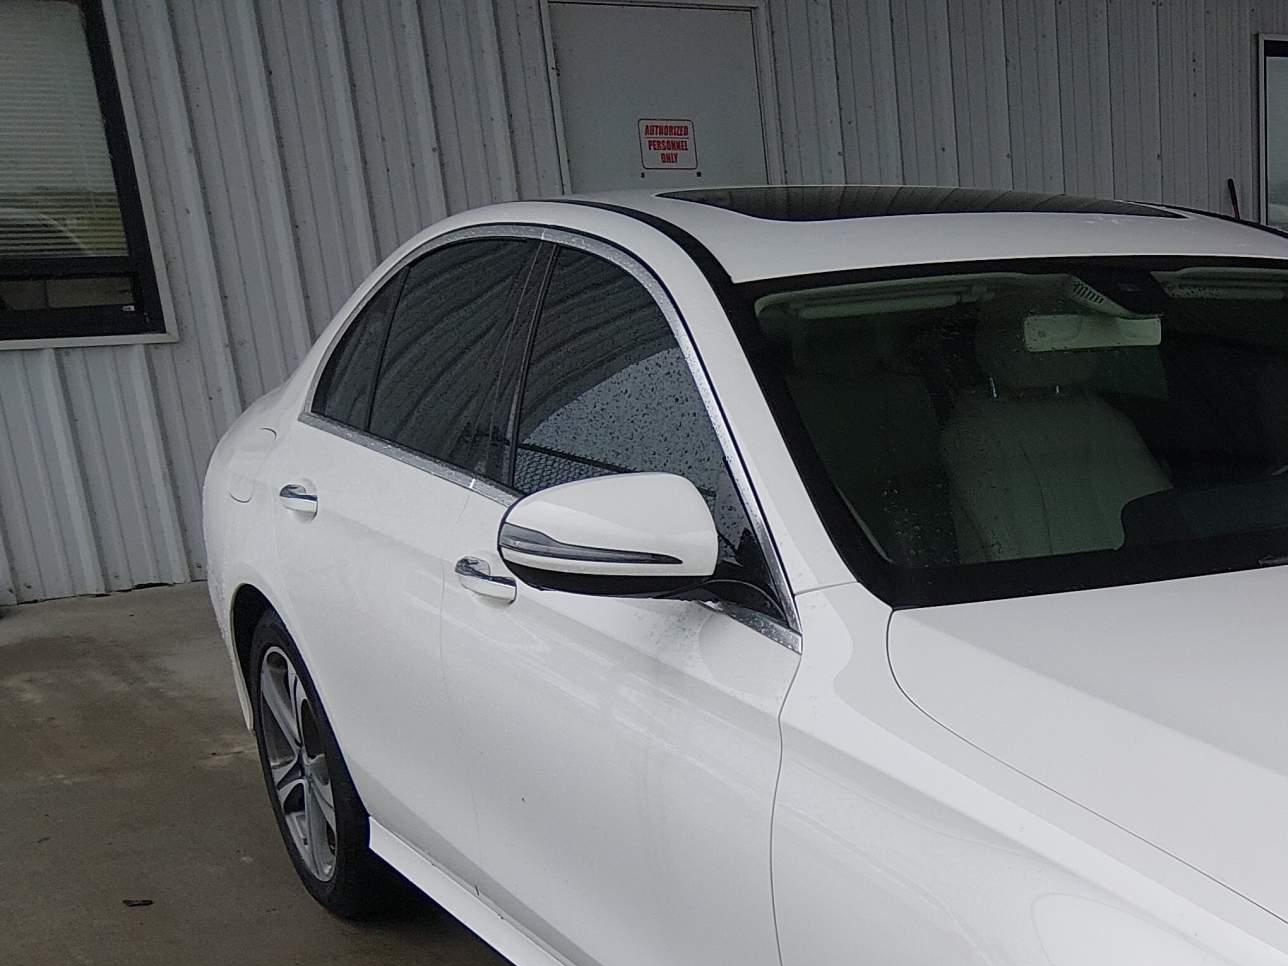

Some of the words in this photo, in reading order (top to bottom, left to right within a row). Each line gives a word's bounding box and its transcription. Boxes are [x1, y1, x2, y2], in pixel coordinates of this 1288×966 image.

[644, 125, 689, 136] AUTHORIZED
[648, 140, 688, 151] PERSONNEL
[660, 153, 678, 164] ONLY
